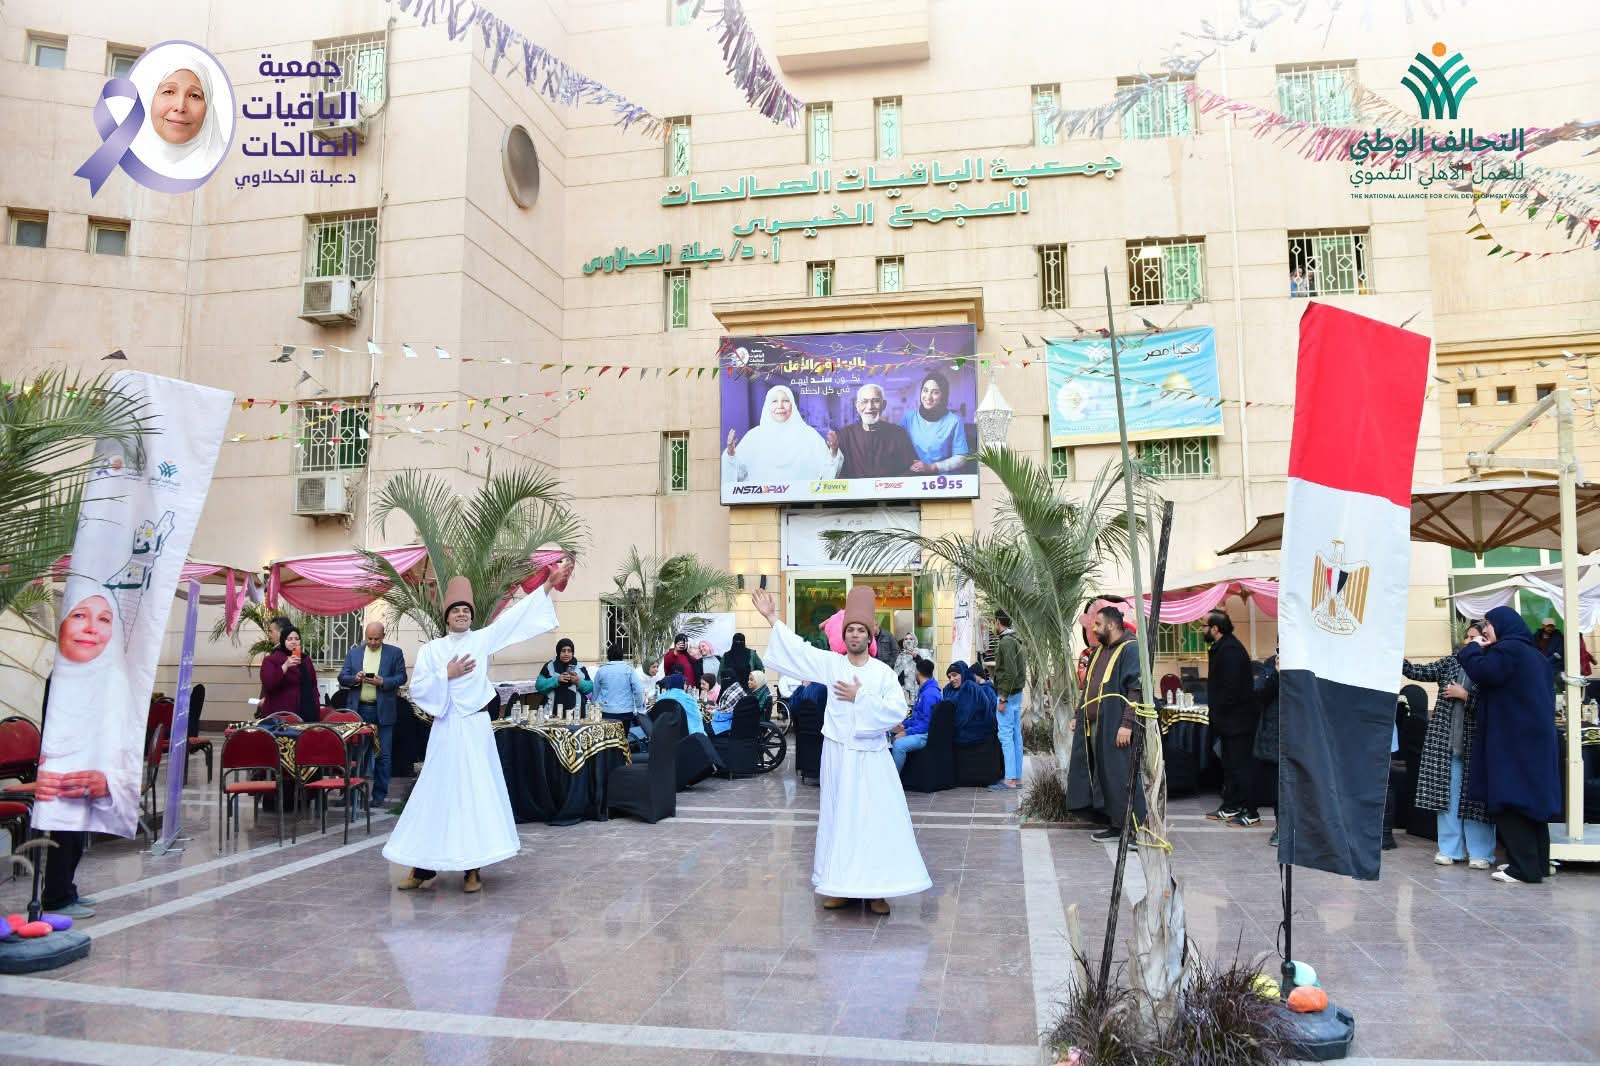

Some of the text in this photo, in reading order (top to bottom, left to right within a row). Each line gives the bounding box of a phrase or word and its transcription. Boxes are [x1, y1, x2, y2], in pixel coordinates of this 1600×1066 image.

[660, 155, 1124, 207] جمعية الباقيات الصالحات
[888, 190, 1030, 228] المجمع
[679, 241, 725, 269] عبلة
[1141, 342, 1201, 361] تحيا مصر
[921, 475, 963, 490] 16955
